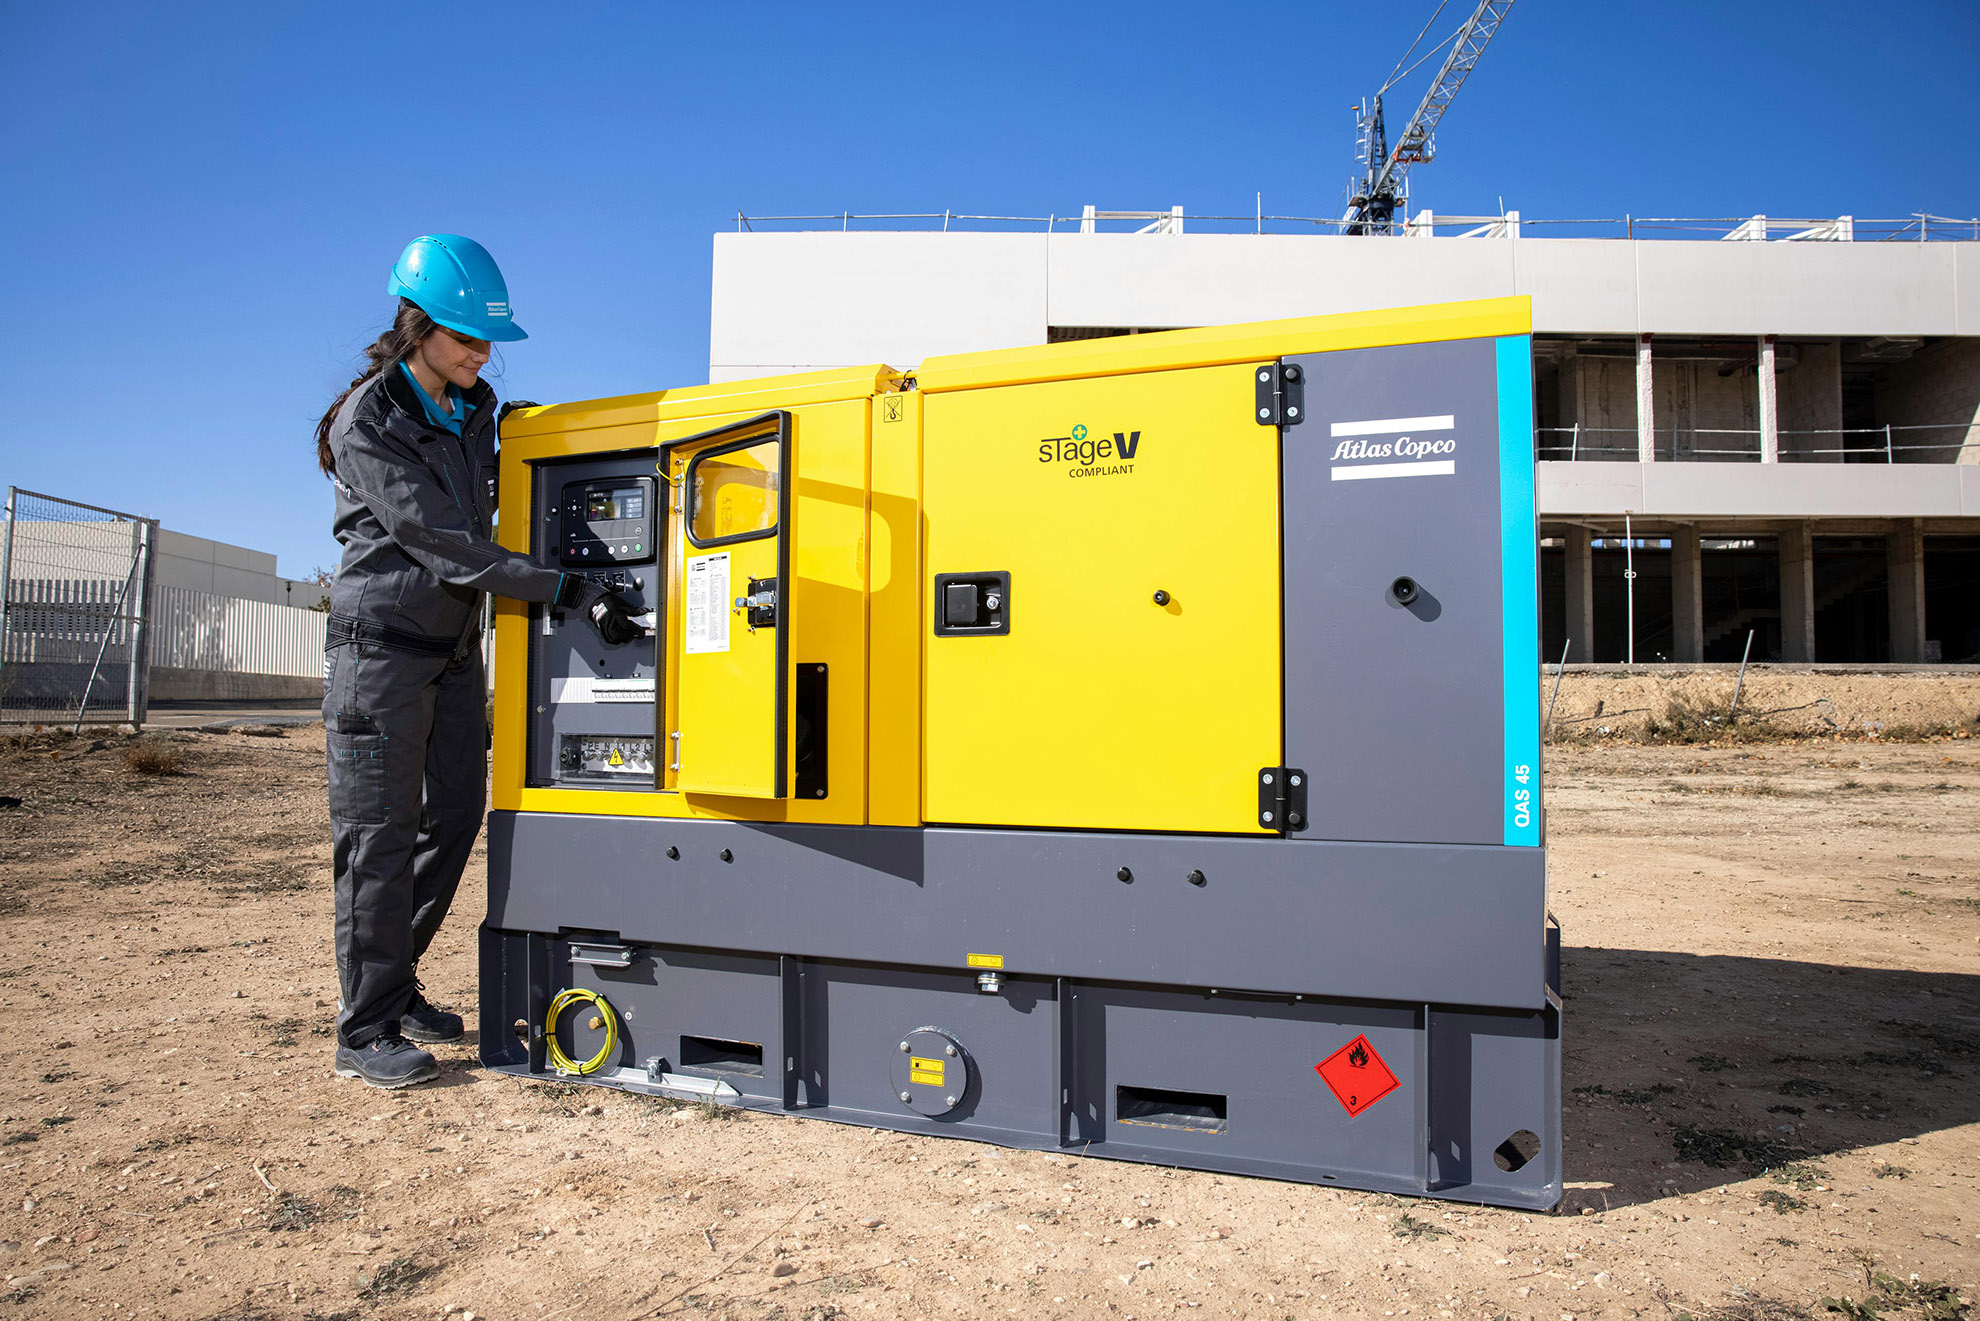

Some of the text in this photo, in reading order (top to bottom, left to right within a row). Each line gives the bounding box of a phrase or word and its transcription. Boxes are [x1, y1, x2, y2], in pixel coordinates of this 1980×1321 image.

[1113, 431, 1141, 459] V
[1069, 465, 1134, 478] COMPLIANT
[1514, 764, 1530, 827] QAS 45
[1350, 1095, 1357, 1106] 3
